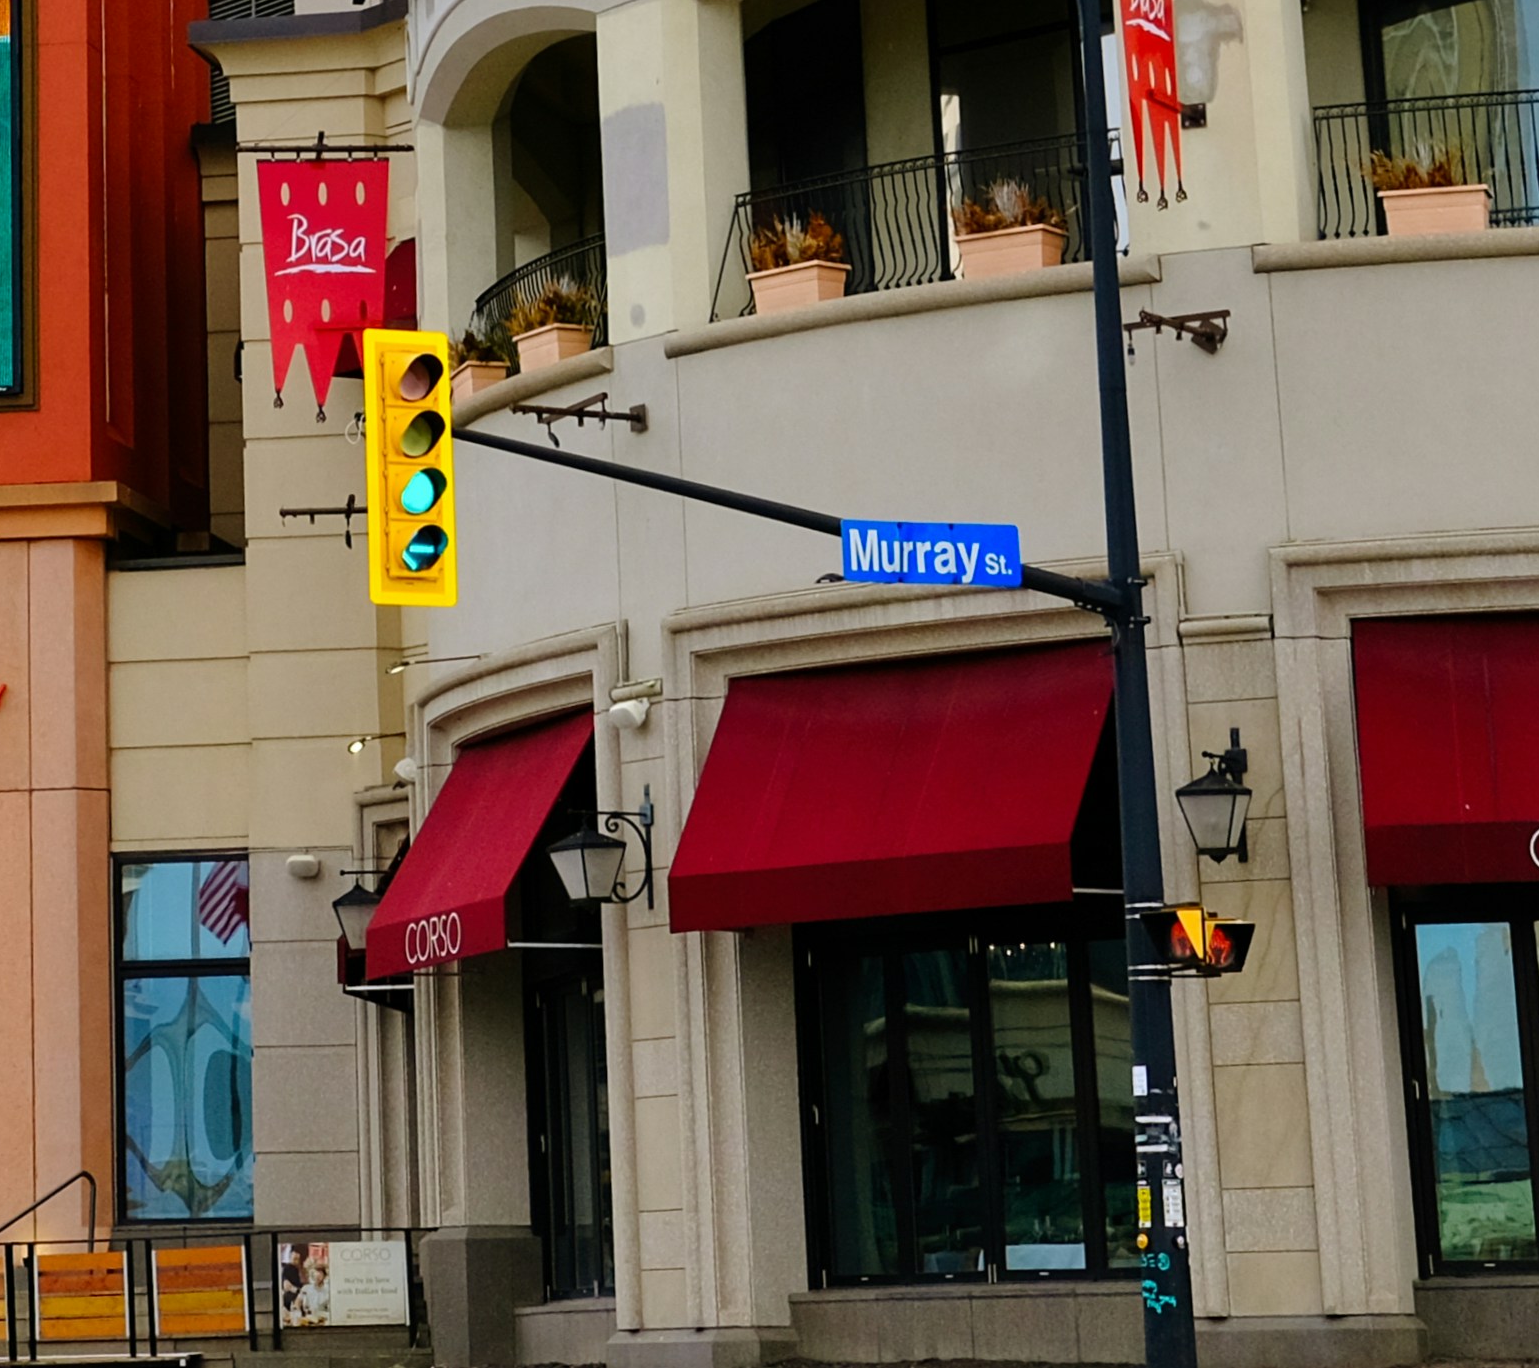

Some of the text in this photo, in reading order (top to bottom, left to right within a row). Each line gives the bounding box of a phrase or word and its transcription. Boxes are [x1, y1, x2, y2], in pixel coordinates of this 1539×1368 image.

[285, 213, 366, 263] Brasa
[848, 528, 1013, 584] Murray St.
[405, 912, 461, 964] CORSO
[339, 1247, 392, 1262] CORSO
